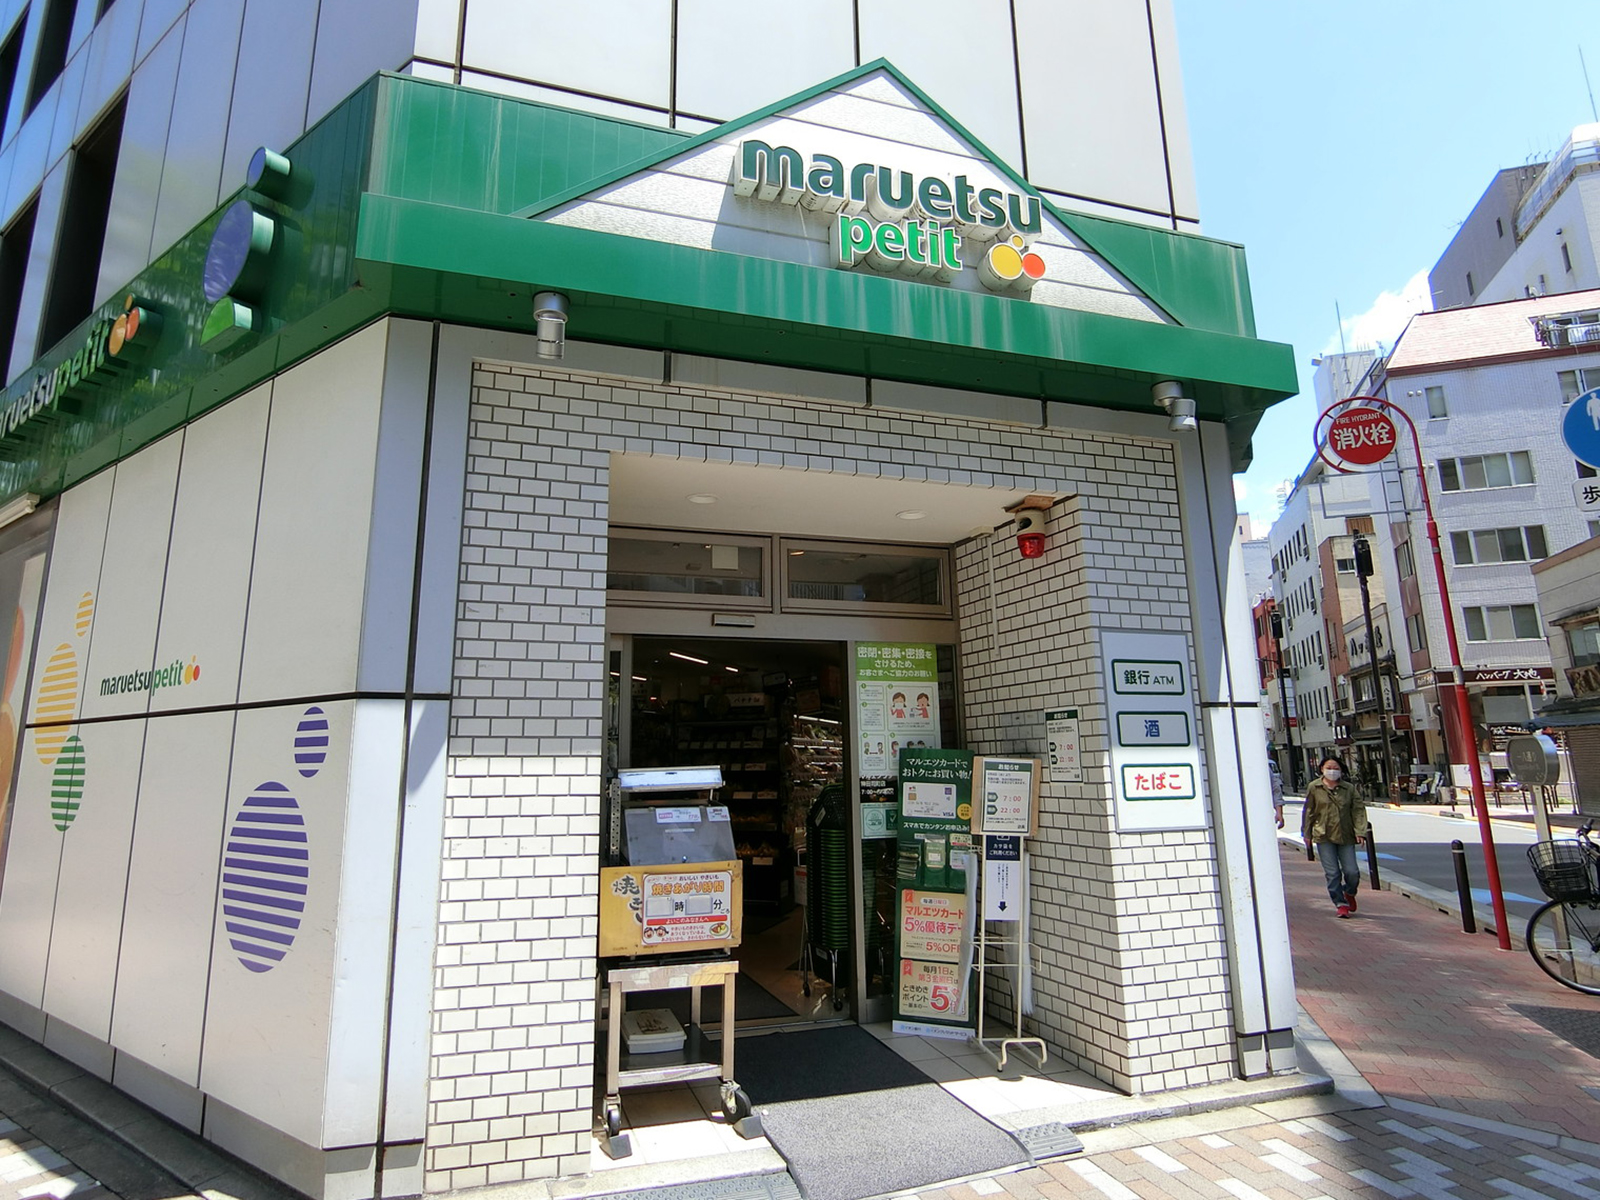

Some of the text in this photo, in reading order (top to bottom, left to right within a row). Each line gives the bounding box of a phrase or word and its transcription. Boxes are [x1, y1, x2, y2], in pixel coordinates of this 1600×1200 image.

[740, 139, 1042, 236] maruetsu
[838, 213, 963, 271] petit
[0, 367, 59, 439] ruetsu
[1335, 412, 1381, 425] FIRE HYDRANT
[1333, 423, 1393, 450] 消火栓
[99, 659, 184, 697] maruetsu petit
[1123, 669, 1175, 686] 銀行 ATM
[1476, 668, 1541, 681] ハンバーグ 大地
[1144, 719, 1161, 738] 酒
[906, 758, 969, 769] マルエツカードで
[997, 763, 1020, 771] お知らせ
[1134, 772, 1182, 791] たばこ
[652, 880, 725, 896] 焼きあがり時間
[674, 901, 684, 912] 時
[713, 899, 723, 910] 分
[905, 905, 964, 919] マルエツカード
[902, 984, 929, 994] ときめき
[902, 993, 929, 1003] ポイント
